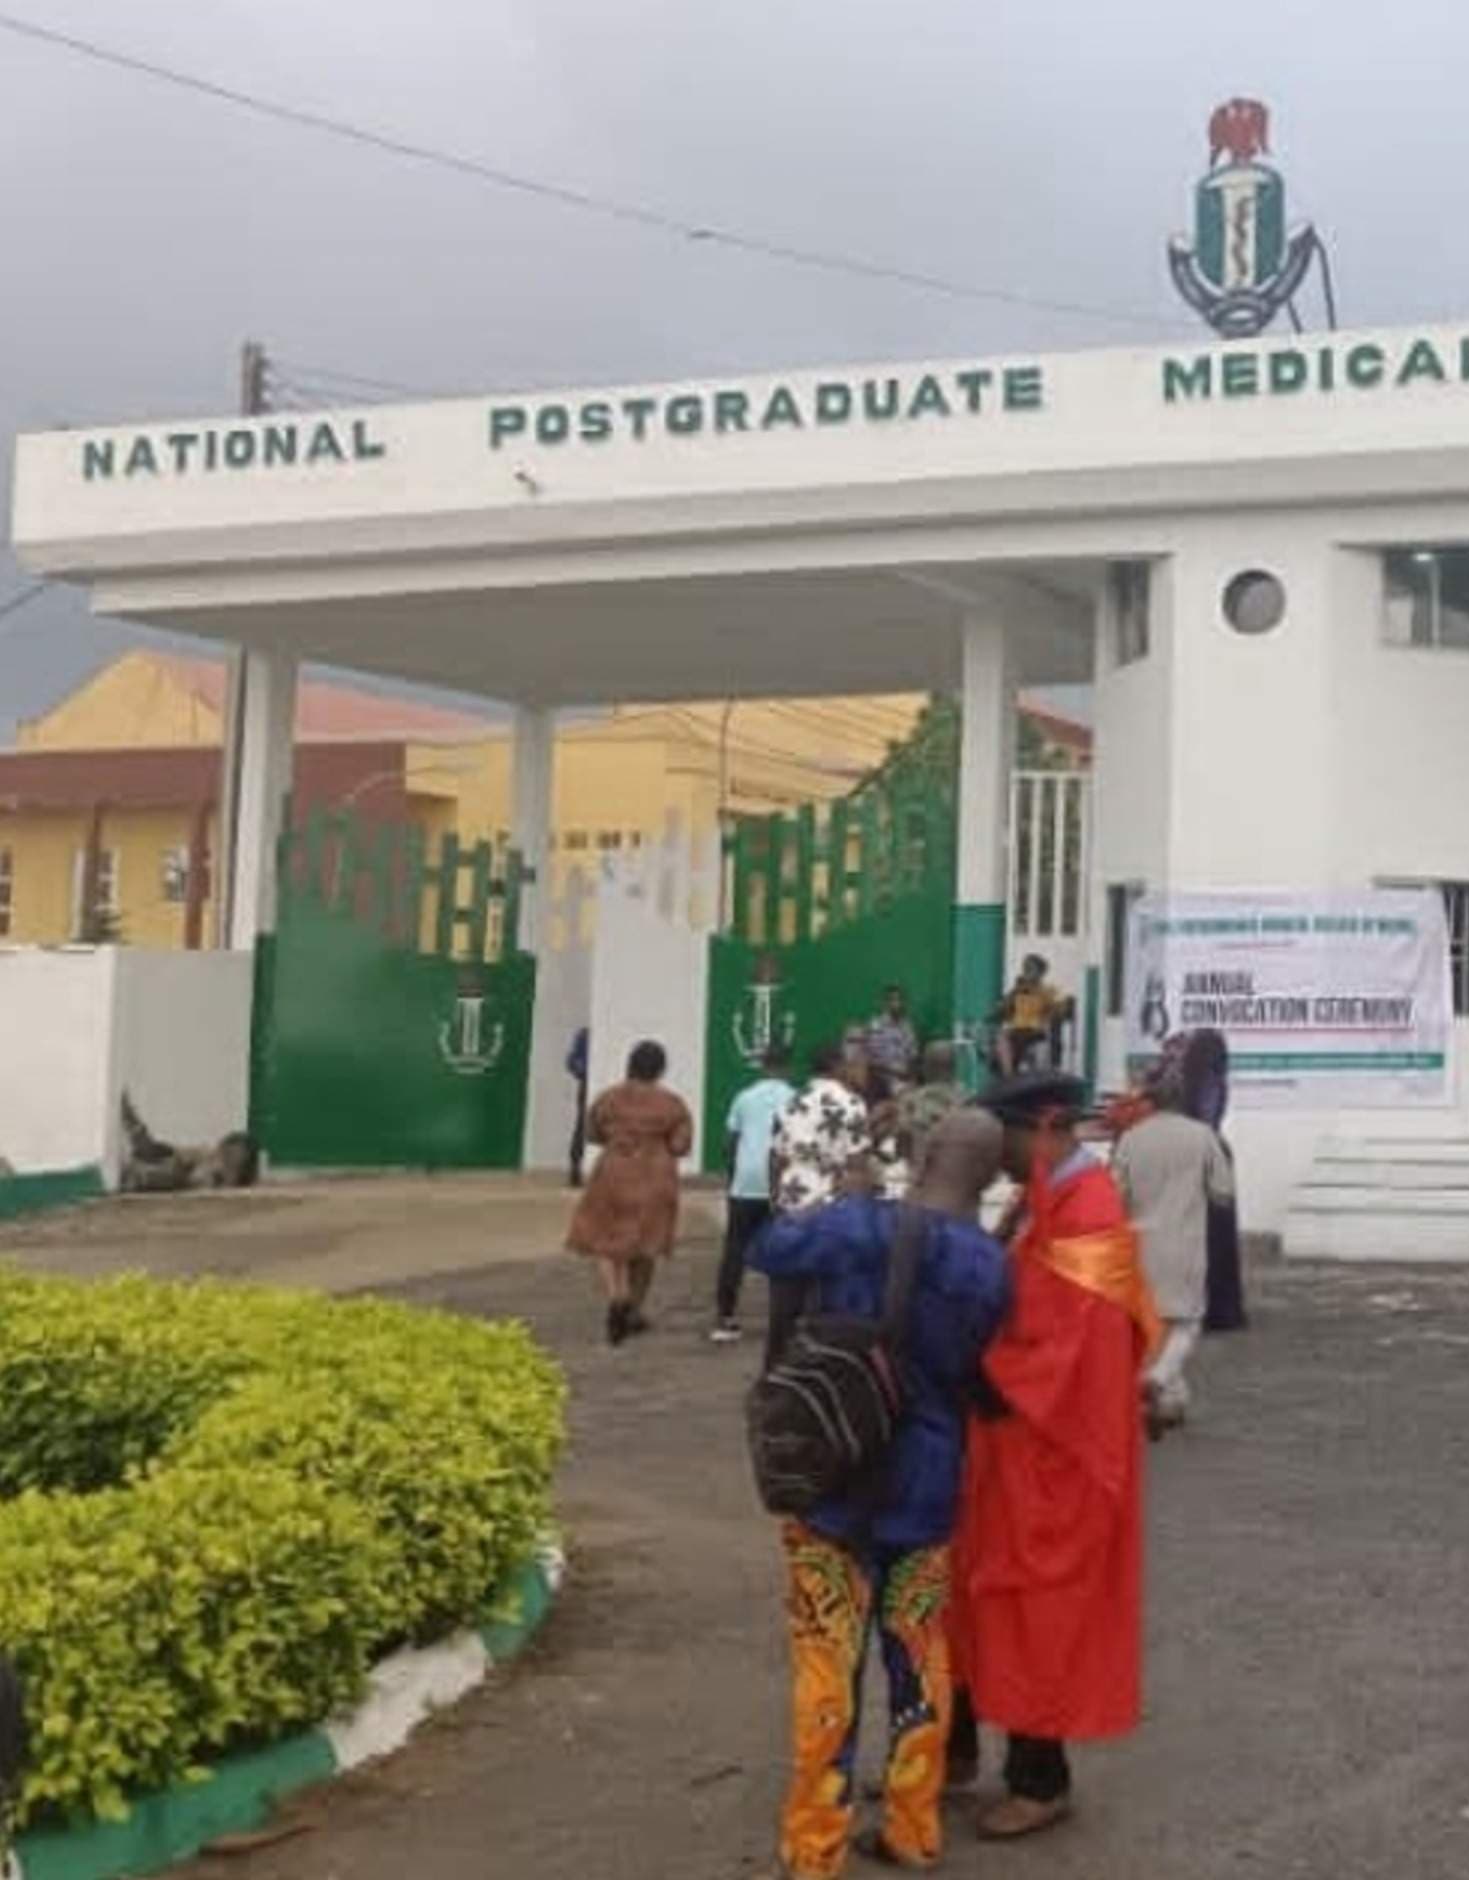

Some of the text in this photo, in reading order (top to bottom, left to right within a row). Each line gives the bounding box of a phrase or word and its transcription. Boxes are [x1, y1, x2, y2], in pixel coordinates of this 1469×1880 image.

[83, 420, 385, 481] NATIONAL
[490, 367, 1042, 450] POSTGRADUATE
[1183, 971, 1254, 995] ANNUAL
[1181, 997, 1307, 1025] CONVOCATION
[1314, 996, 1412, 1024] CEREMONY
